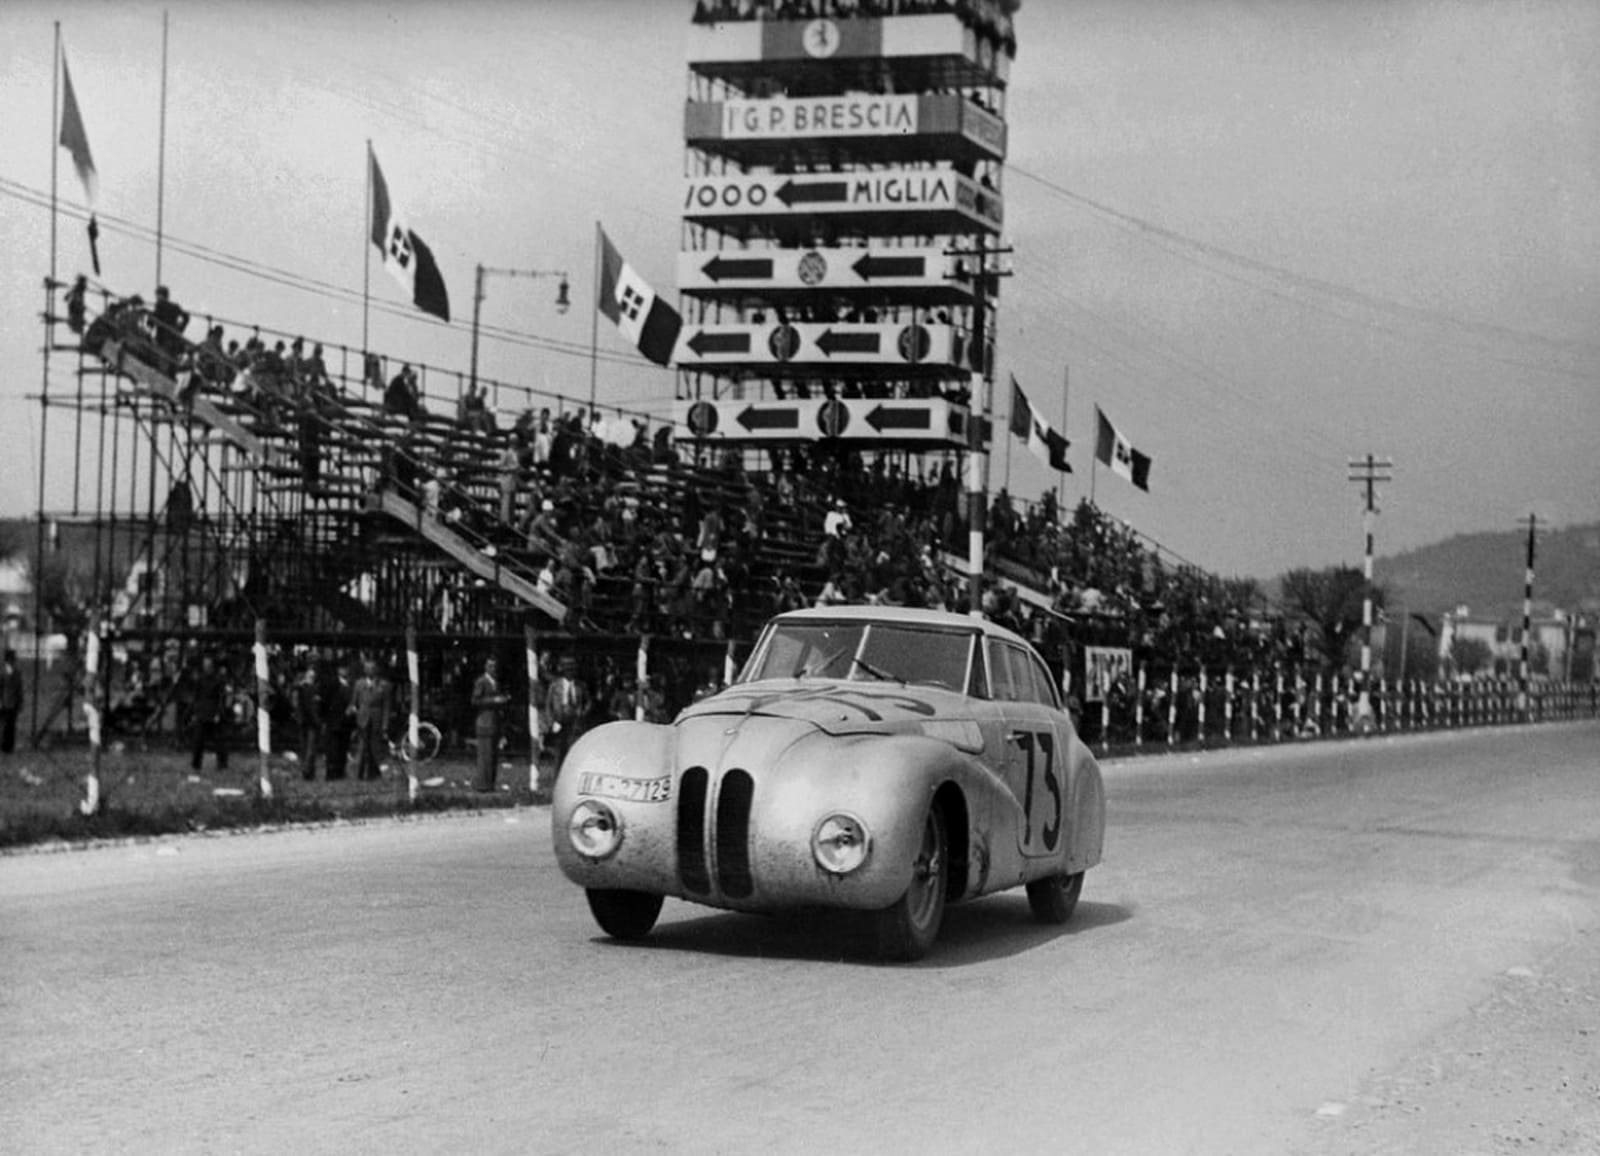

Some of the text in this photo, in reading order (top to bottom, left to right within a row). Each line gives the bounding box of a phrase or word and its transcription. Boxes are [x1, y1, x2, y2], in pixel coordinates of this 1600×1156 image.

[794, 102, 912, 130] BRESCIA
[684, 178, 950, 209] 1000 MIGLIA
[1012, 729, 1061, 851] 73
